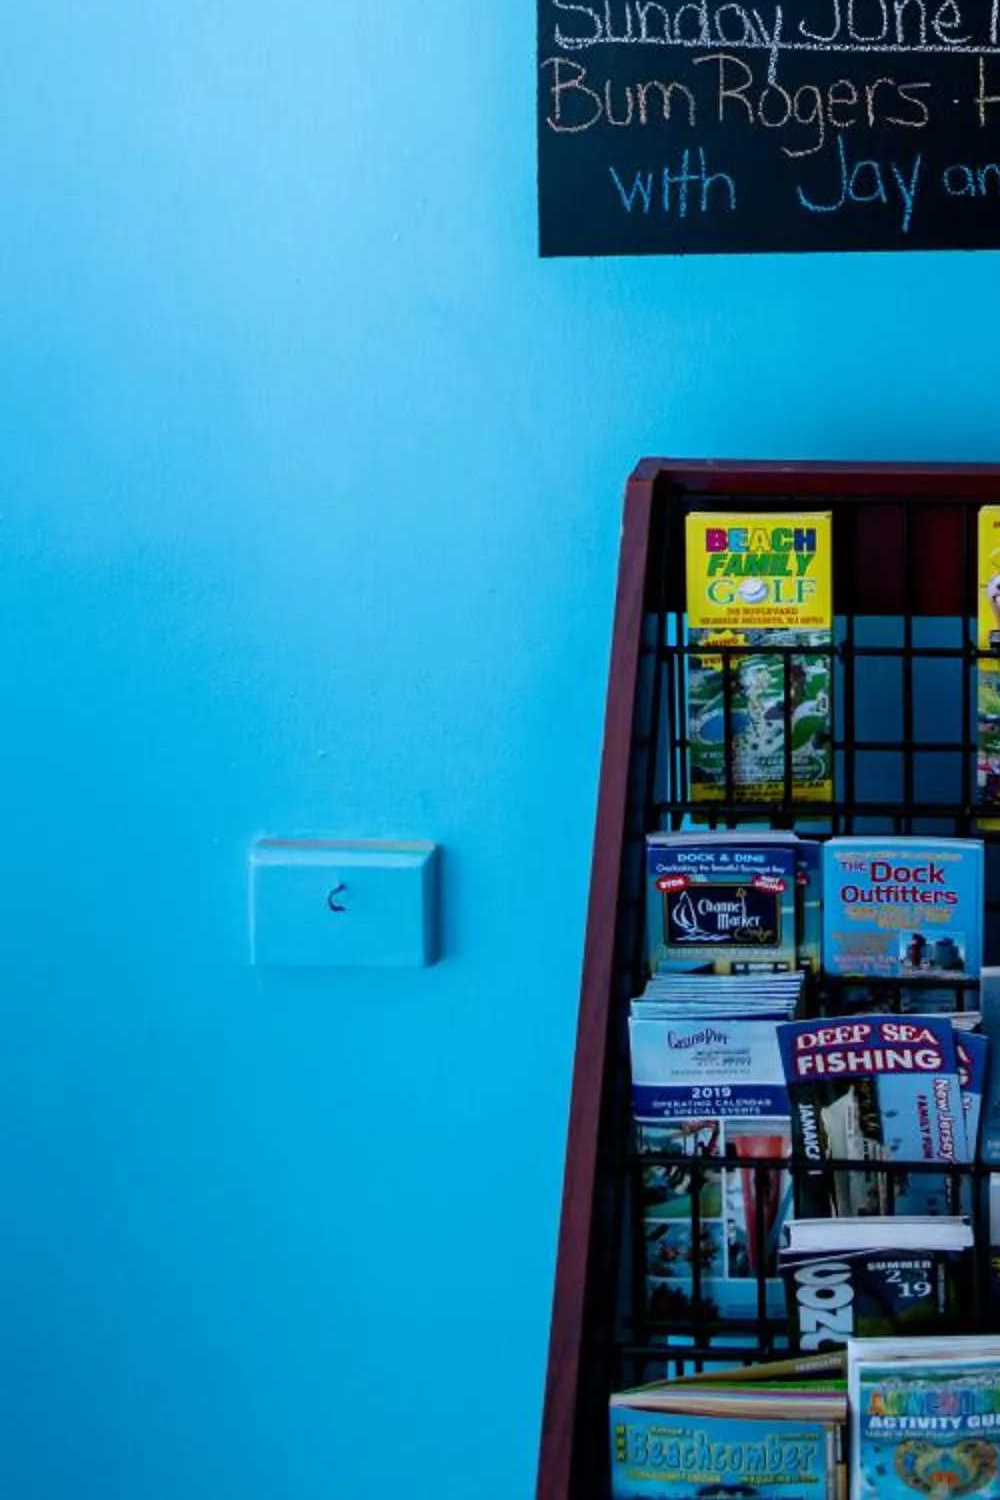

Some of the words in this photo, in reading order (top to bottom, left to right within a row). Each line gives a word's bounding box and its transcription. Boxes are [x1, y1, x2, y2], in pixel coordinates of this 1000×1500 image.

[541, 56, 697, 133] Bum
[692, 52, 932, 158] Rogers
[609, 147, 737, 217] with
[797, 133, 921, 233] Jay
[705, 527, 817, 552] BEACH
[706, 553, 817, 577] FAMILY
[677, 853, 716, 863] DOCK
[734, 854, 766, 864] DINE
[871, 861, 945, 884] Dock
[840, 885, 958, 905] Outfitters
[796, 1022, 872, 1050] DEEP
[880, 1022, 940, 1046] SEA
[796, 1048, 944, 1075] FISHING
[691, 1086, 733, 1099] 2019
[866, 1259, 932, 1271] SUMMER
[867, 1414, 962, 1430] ACTIVITY
[630, 1429, 818, 1473] Beachcomber
